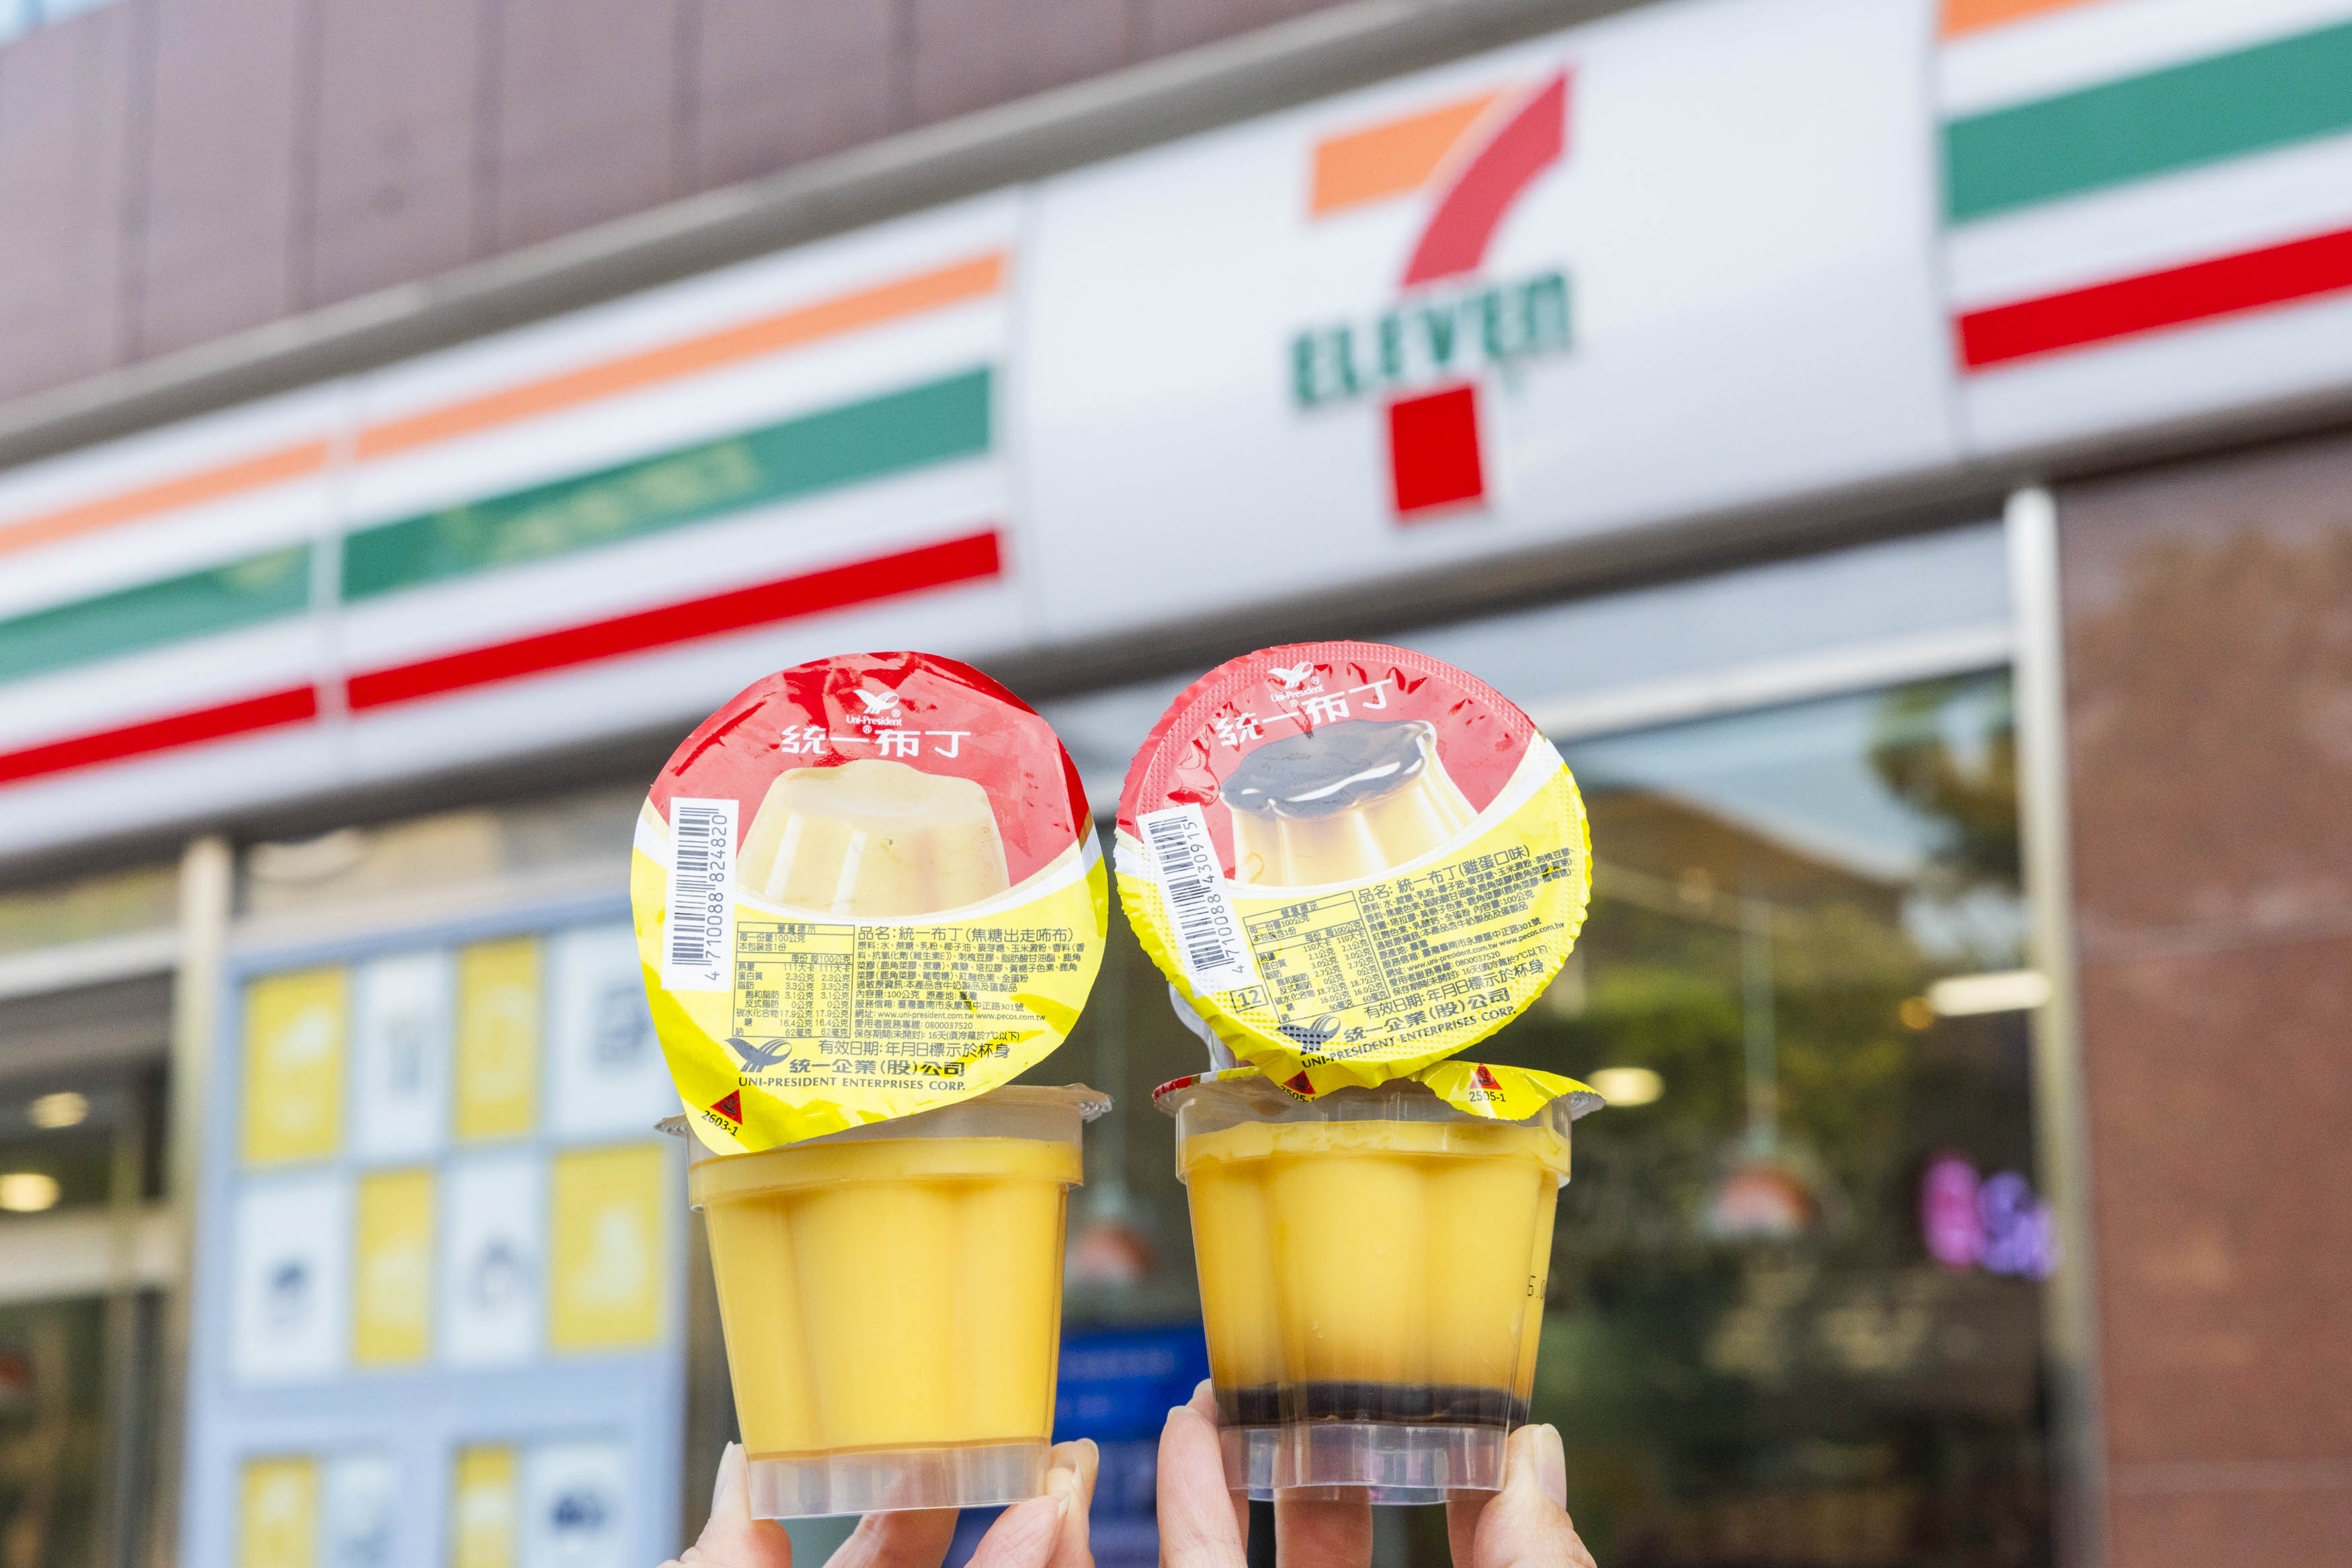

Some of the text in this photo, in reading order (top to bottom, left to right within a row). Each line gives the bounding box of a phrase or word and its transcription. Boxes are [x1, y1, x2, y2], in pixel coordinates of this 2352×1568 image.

[1269, 685, 1325, 702] Uni-President
[846, 715, 902, 726] Uni-President
[1215, 679, 1393, 747] 統一布丁
[781, 725, 972, 758] 統一布丁
[705, 971, 720, 981] 4
[1237, 989, 1261, 1007] 12
[1301, 1004, 1516, 1069] UNI-PRESIDENT ENTERPRISES CORP.
[739, 1077, 966, 1091] UNI-PRESIDENT ENTERPRISES CORP.
[1468, 1090, 1507, 1102] 2505-1
[702, 1110, 739, 1137] 2603-1
